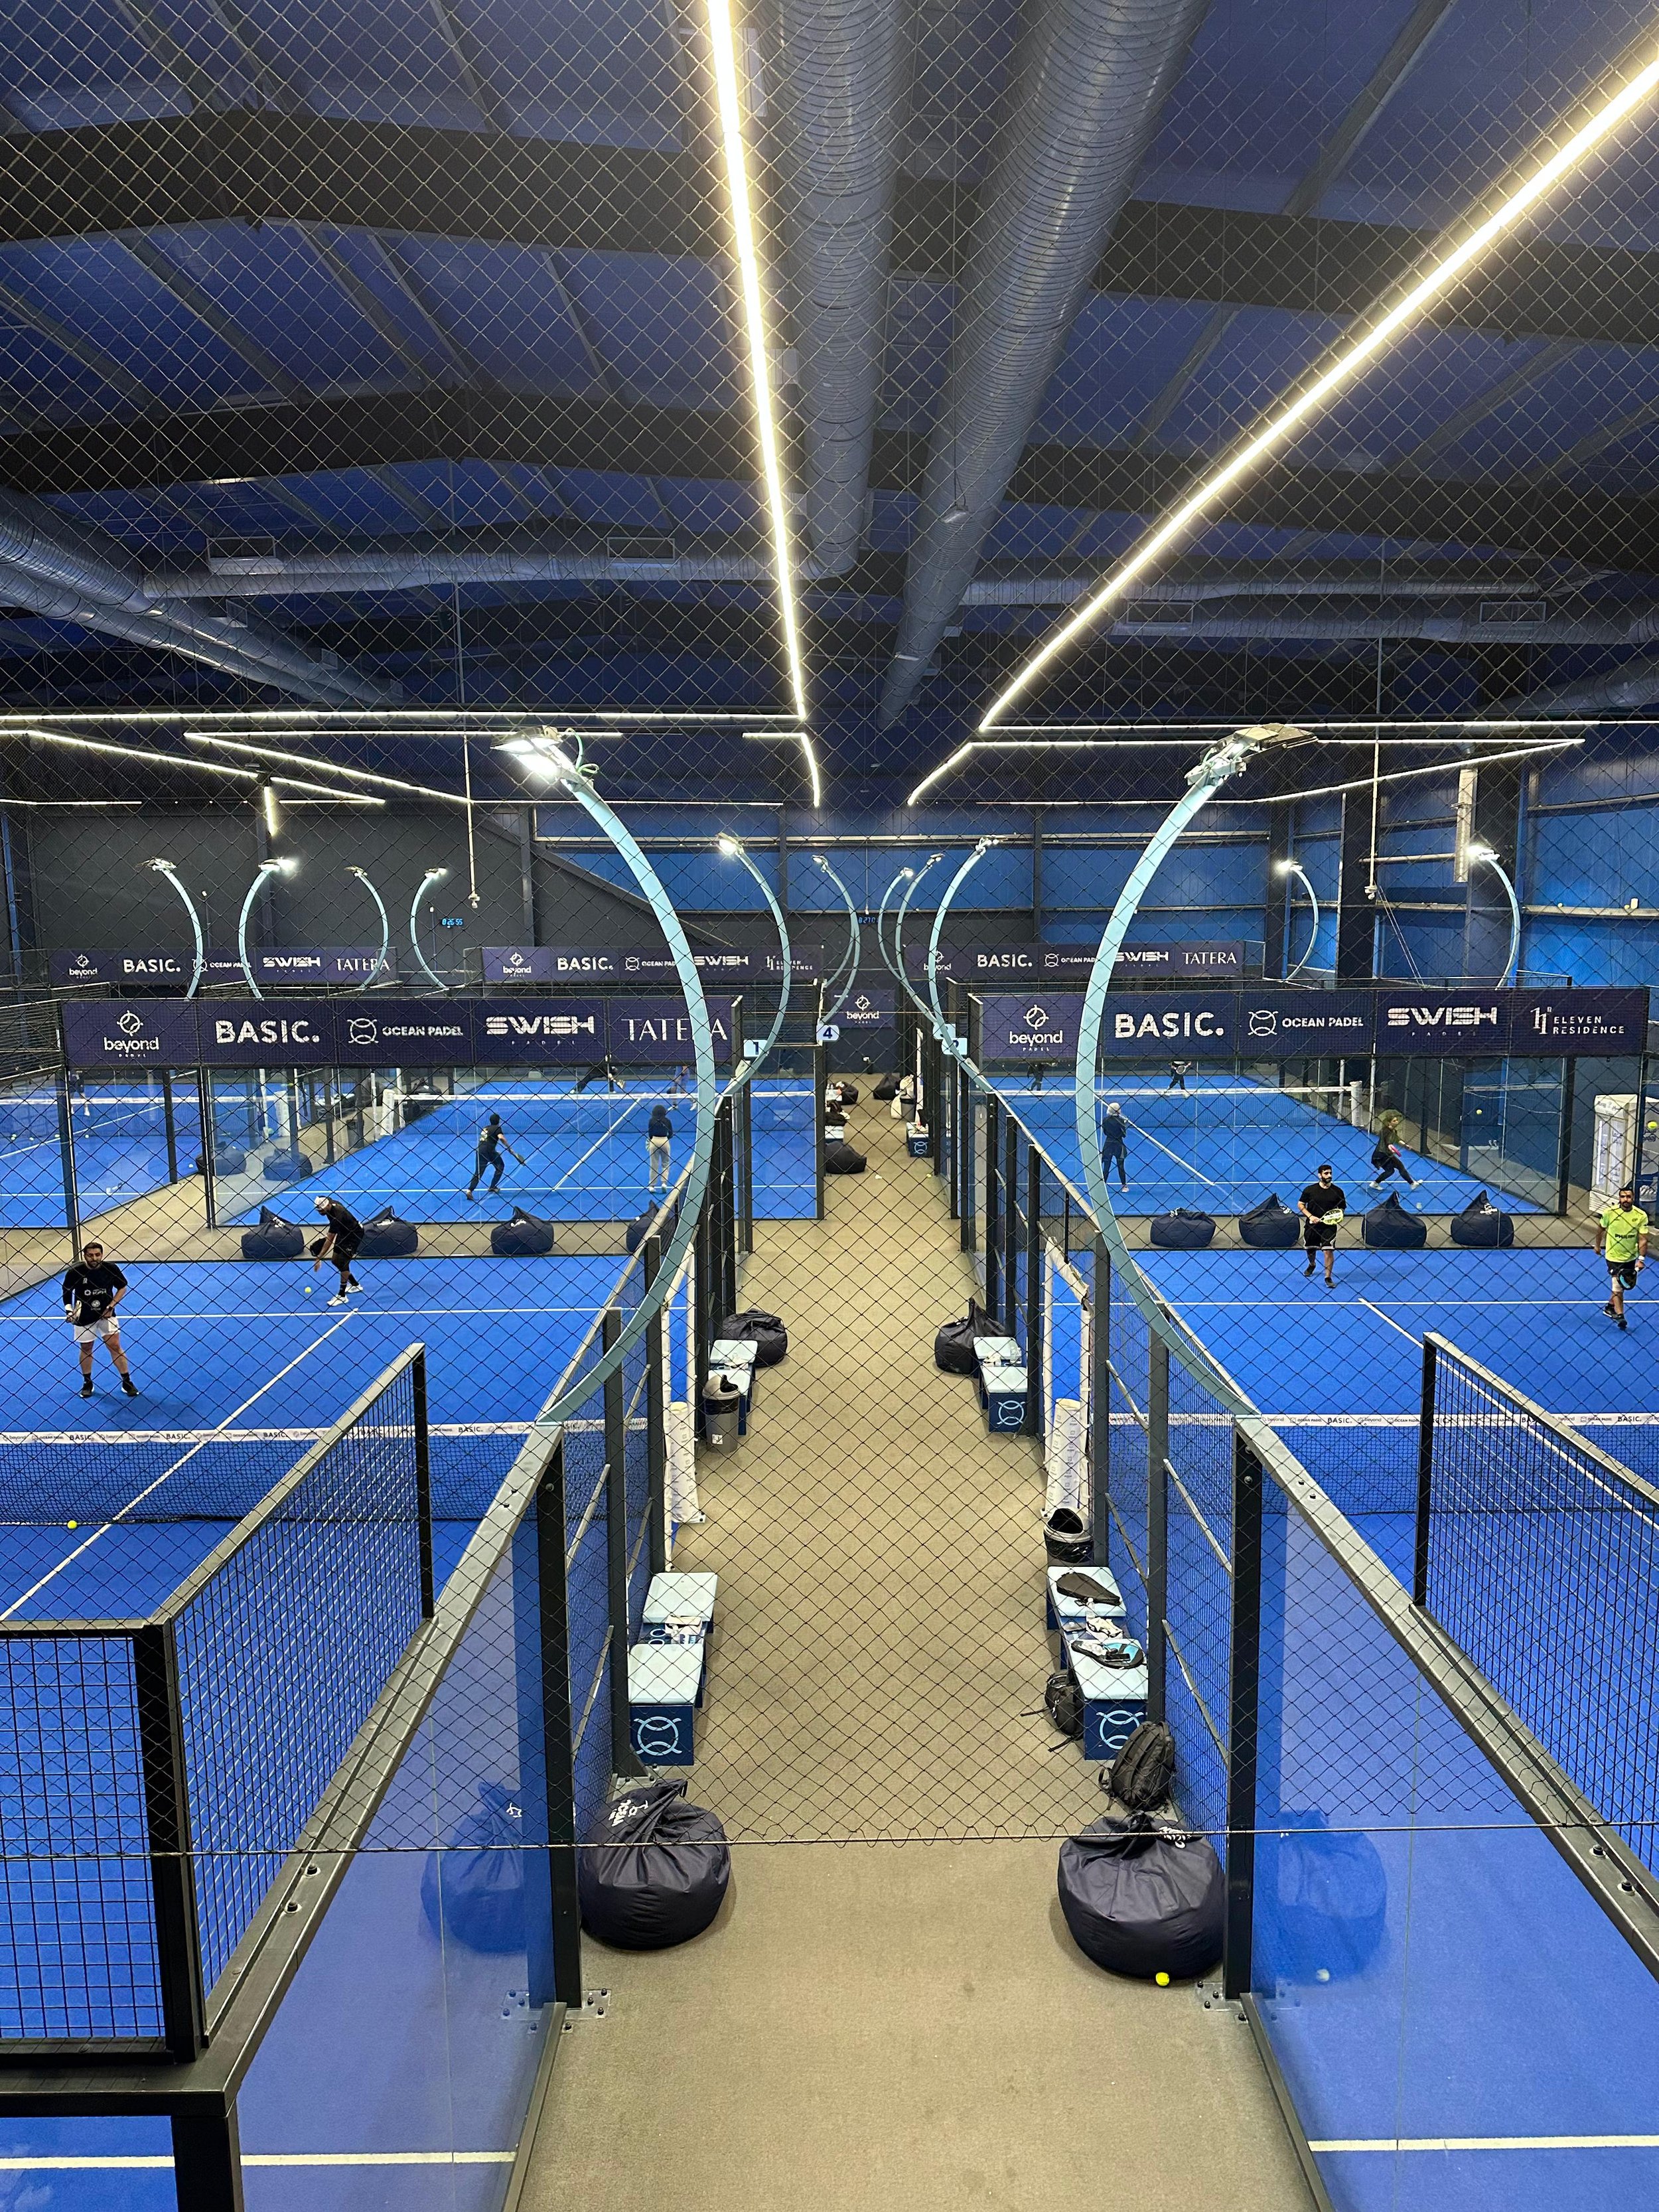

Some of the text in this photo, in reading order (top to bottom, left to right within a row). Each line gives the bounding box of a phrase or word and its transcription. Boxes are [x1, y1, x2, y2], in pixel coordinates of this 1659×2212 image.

[263, 957, 321, 967] SWISH
[557, 957, 614, 970] BASIC.
[693, 956, 749, 966] SWISH
[977, 954, 1033, 968] BASIC.
[1181, 952, 1237, 964] TATERA
[69, 968, 98, 976] beyond
[123, 959, 181, 972] BASIC.
[846, 1011, 879, 1020] beyond
[1282, 1017, 1364, 1027] OCEAN PADEL
[1388, 1007, 1498, 1025] SWISH
[382, 1026, 463, 1037] OCEAN PADEL
[486, 1015, 595, 1035] SWISH
[621, 1018, 728, 1041] TATEA
[1115, 1012, 1224, 1038] BASIC.
[215, 1020, 320, 1044] BASIC.
[823, 1027, 833, 1039] 4
[1009, 1030, 1063, 1047] beyond
[104, 1037, 160, 1053] beyond
[753, 1042, 758, 1055] 1
